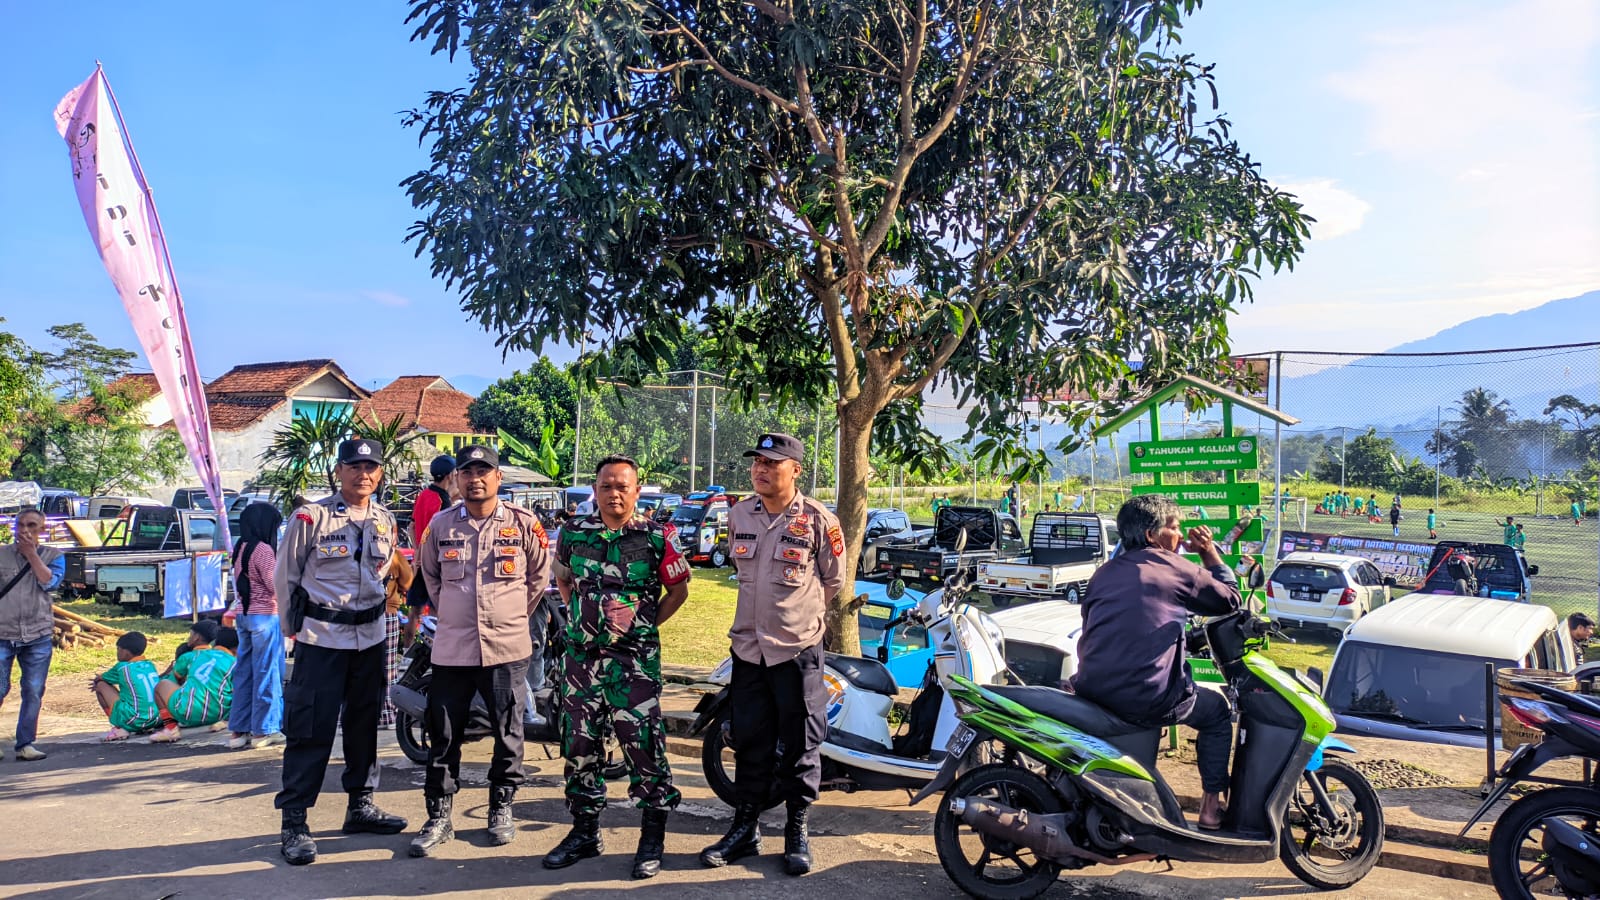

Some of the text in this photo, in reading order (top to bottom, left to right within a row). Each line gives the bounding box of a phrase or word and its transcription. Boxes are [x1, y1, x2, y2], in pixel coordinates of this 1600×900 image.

[1148, 444, 1235, 455] TAHUKAH KALIAN
[1182, 491, 1228, 500] TERURAI
[320, 534, 346, 544] DADAN
[780, 534, 809, 549] POLRI
[194, 657, 217, 686] 4
